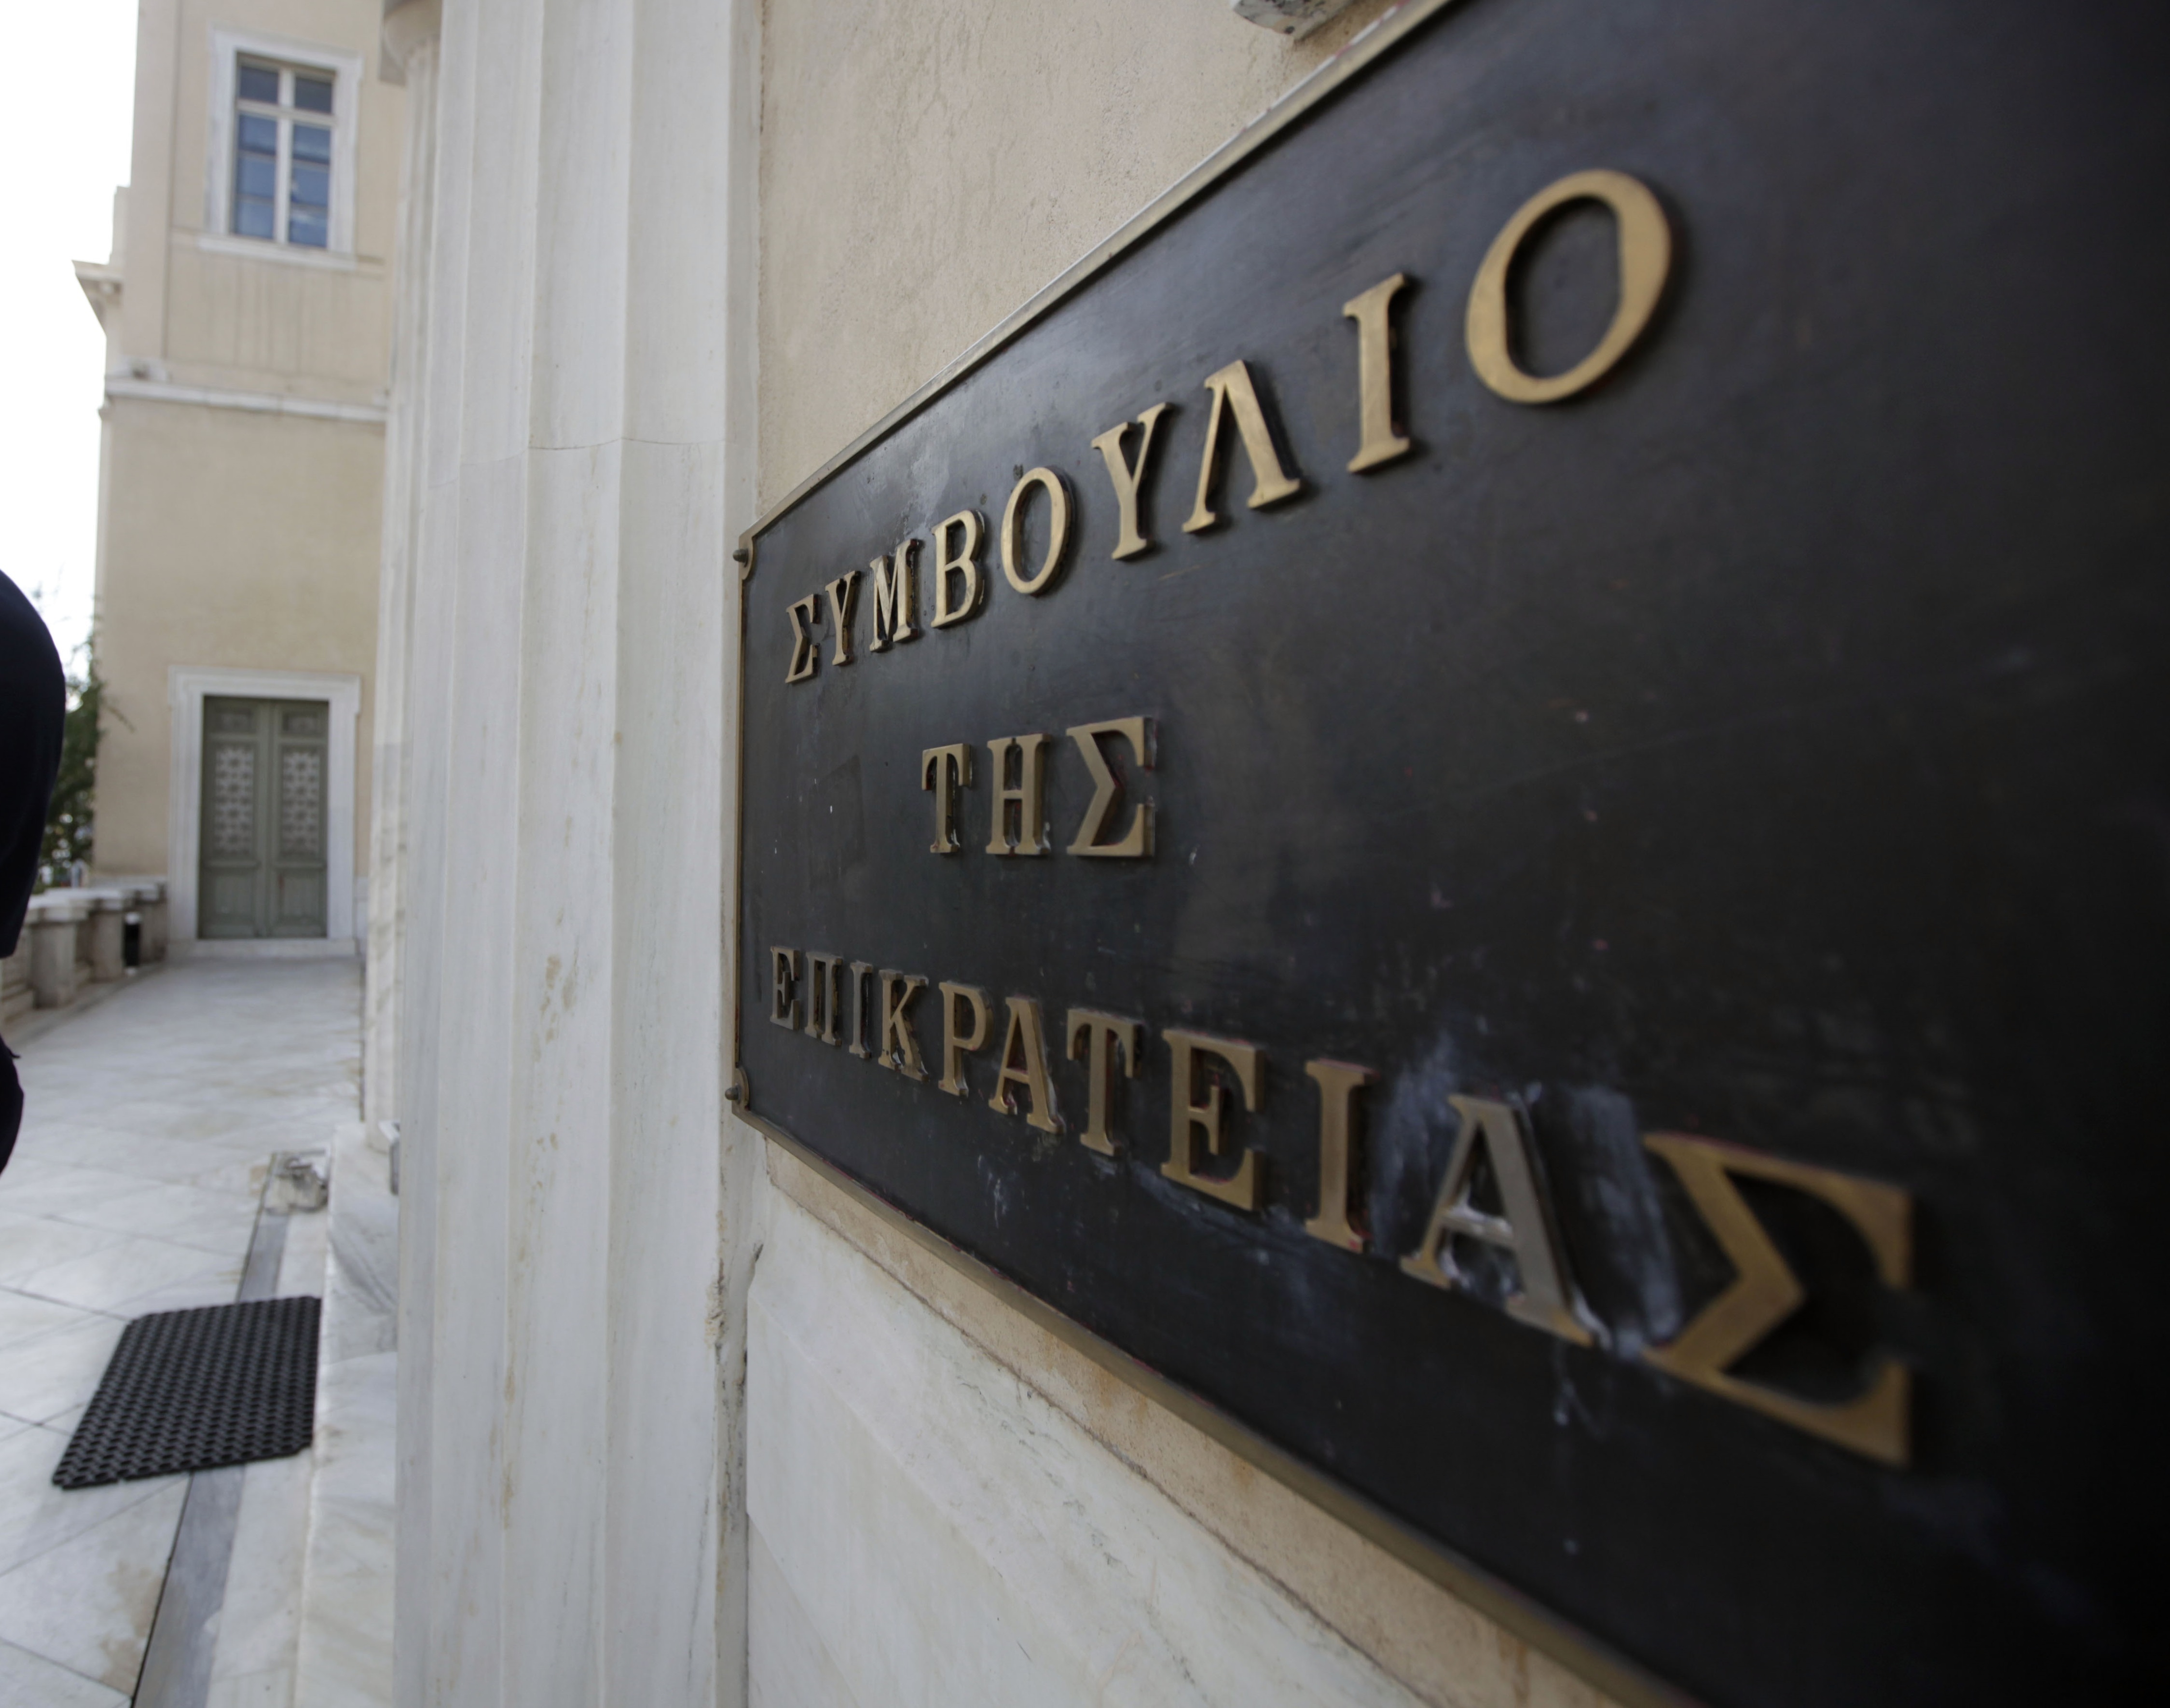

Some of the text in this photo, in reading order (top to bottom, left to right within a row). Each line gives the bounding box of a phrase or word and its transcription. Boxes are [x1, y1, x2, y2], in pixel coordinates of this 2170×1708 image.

[785, 168, 1675, 684] ΣΥΜΒΟΥΛΙΟ
[921, 715, 1158, 857] ΤΗΣ
[768, 945, 1912, 1466] ΕΠΙΚΡΑΤΕΙΑΣ
